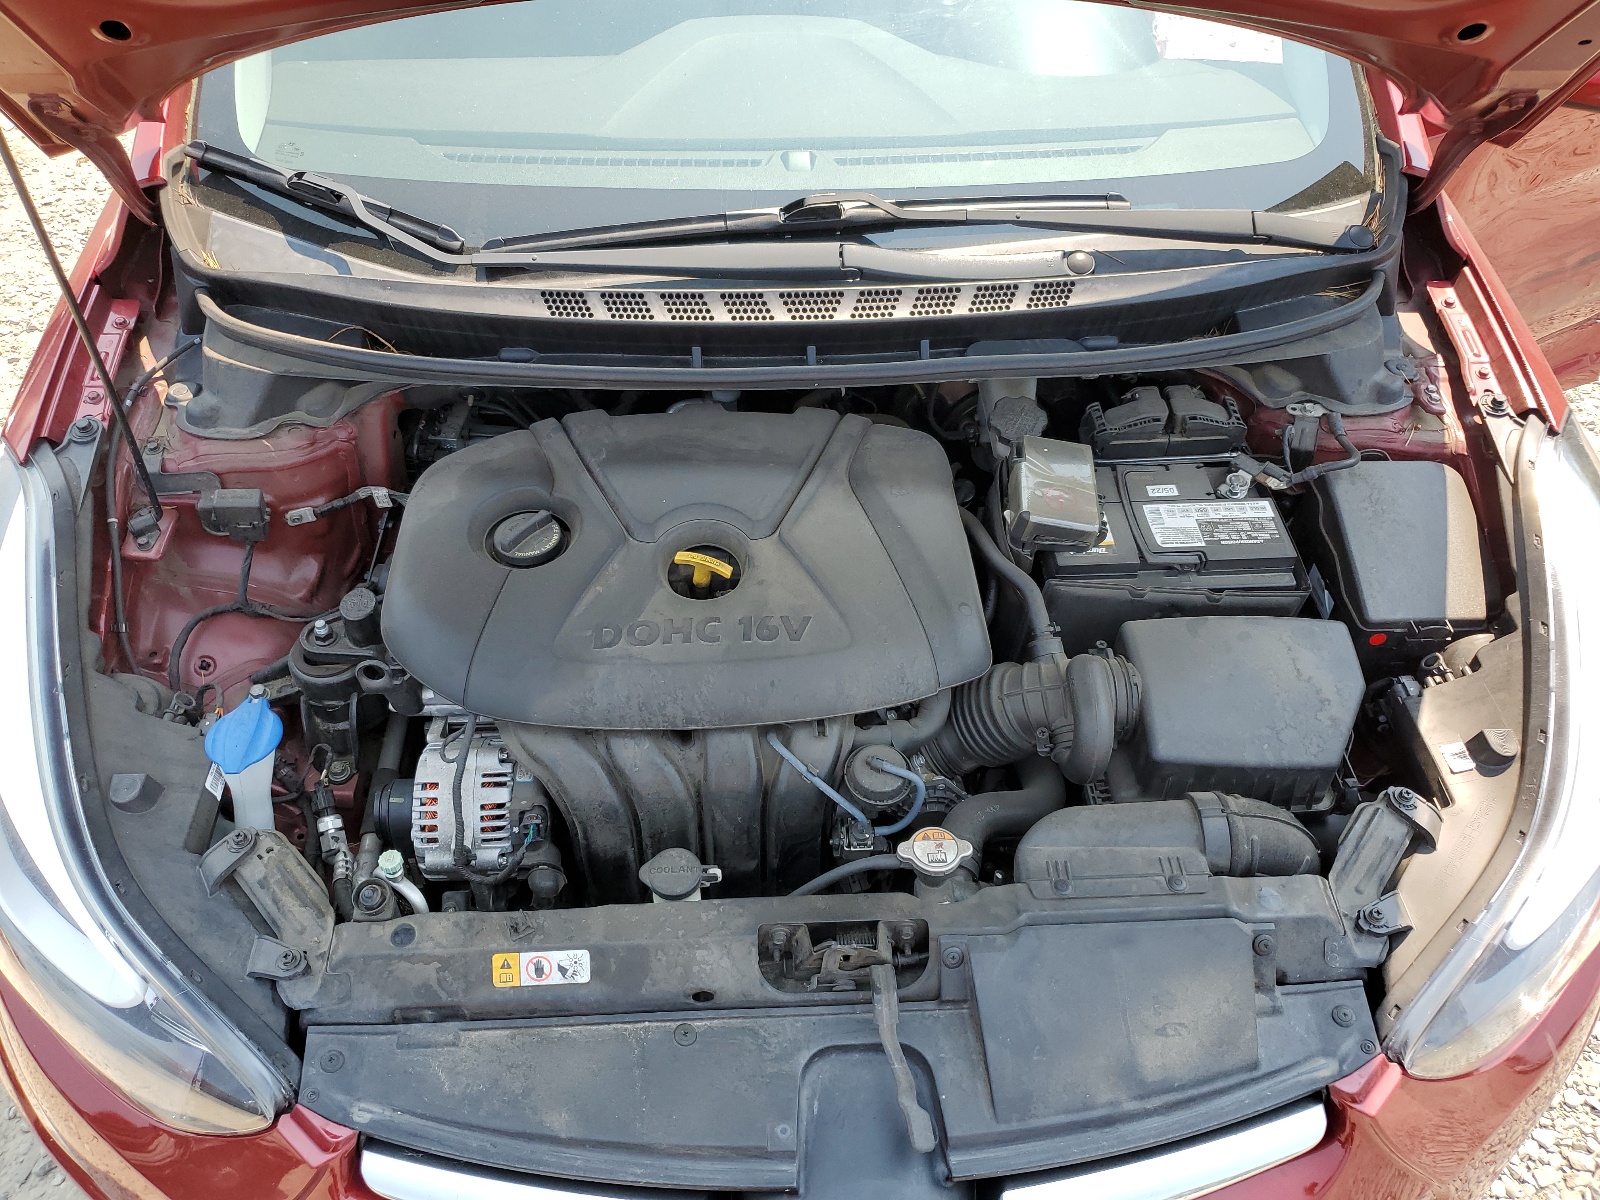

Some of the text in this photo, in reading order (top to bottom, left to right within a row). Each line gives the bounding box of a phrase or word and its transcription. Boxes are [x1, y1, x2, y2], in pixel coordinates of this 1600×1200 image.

[1150, 487, 1175, 496] 05/22
[592, 615, 813, 650] DOHC 16V
[650, 864, 700, 876] COOLANT
